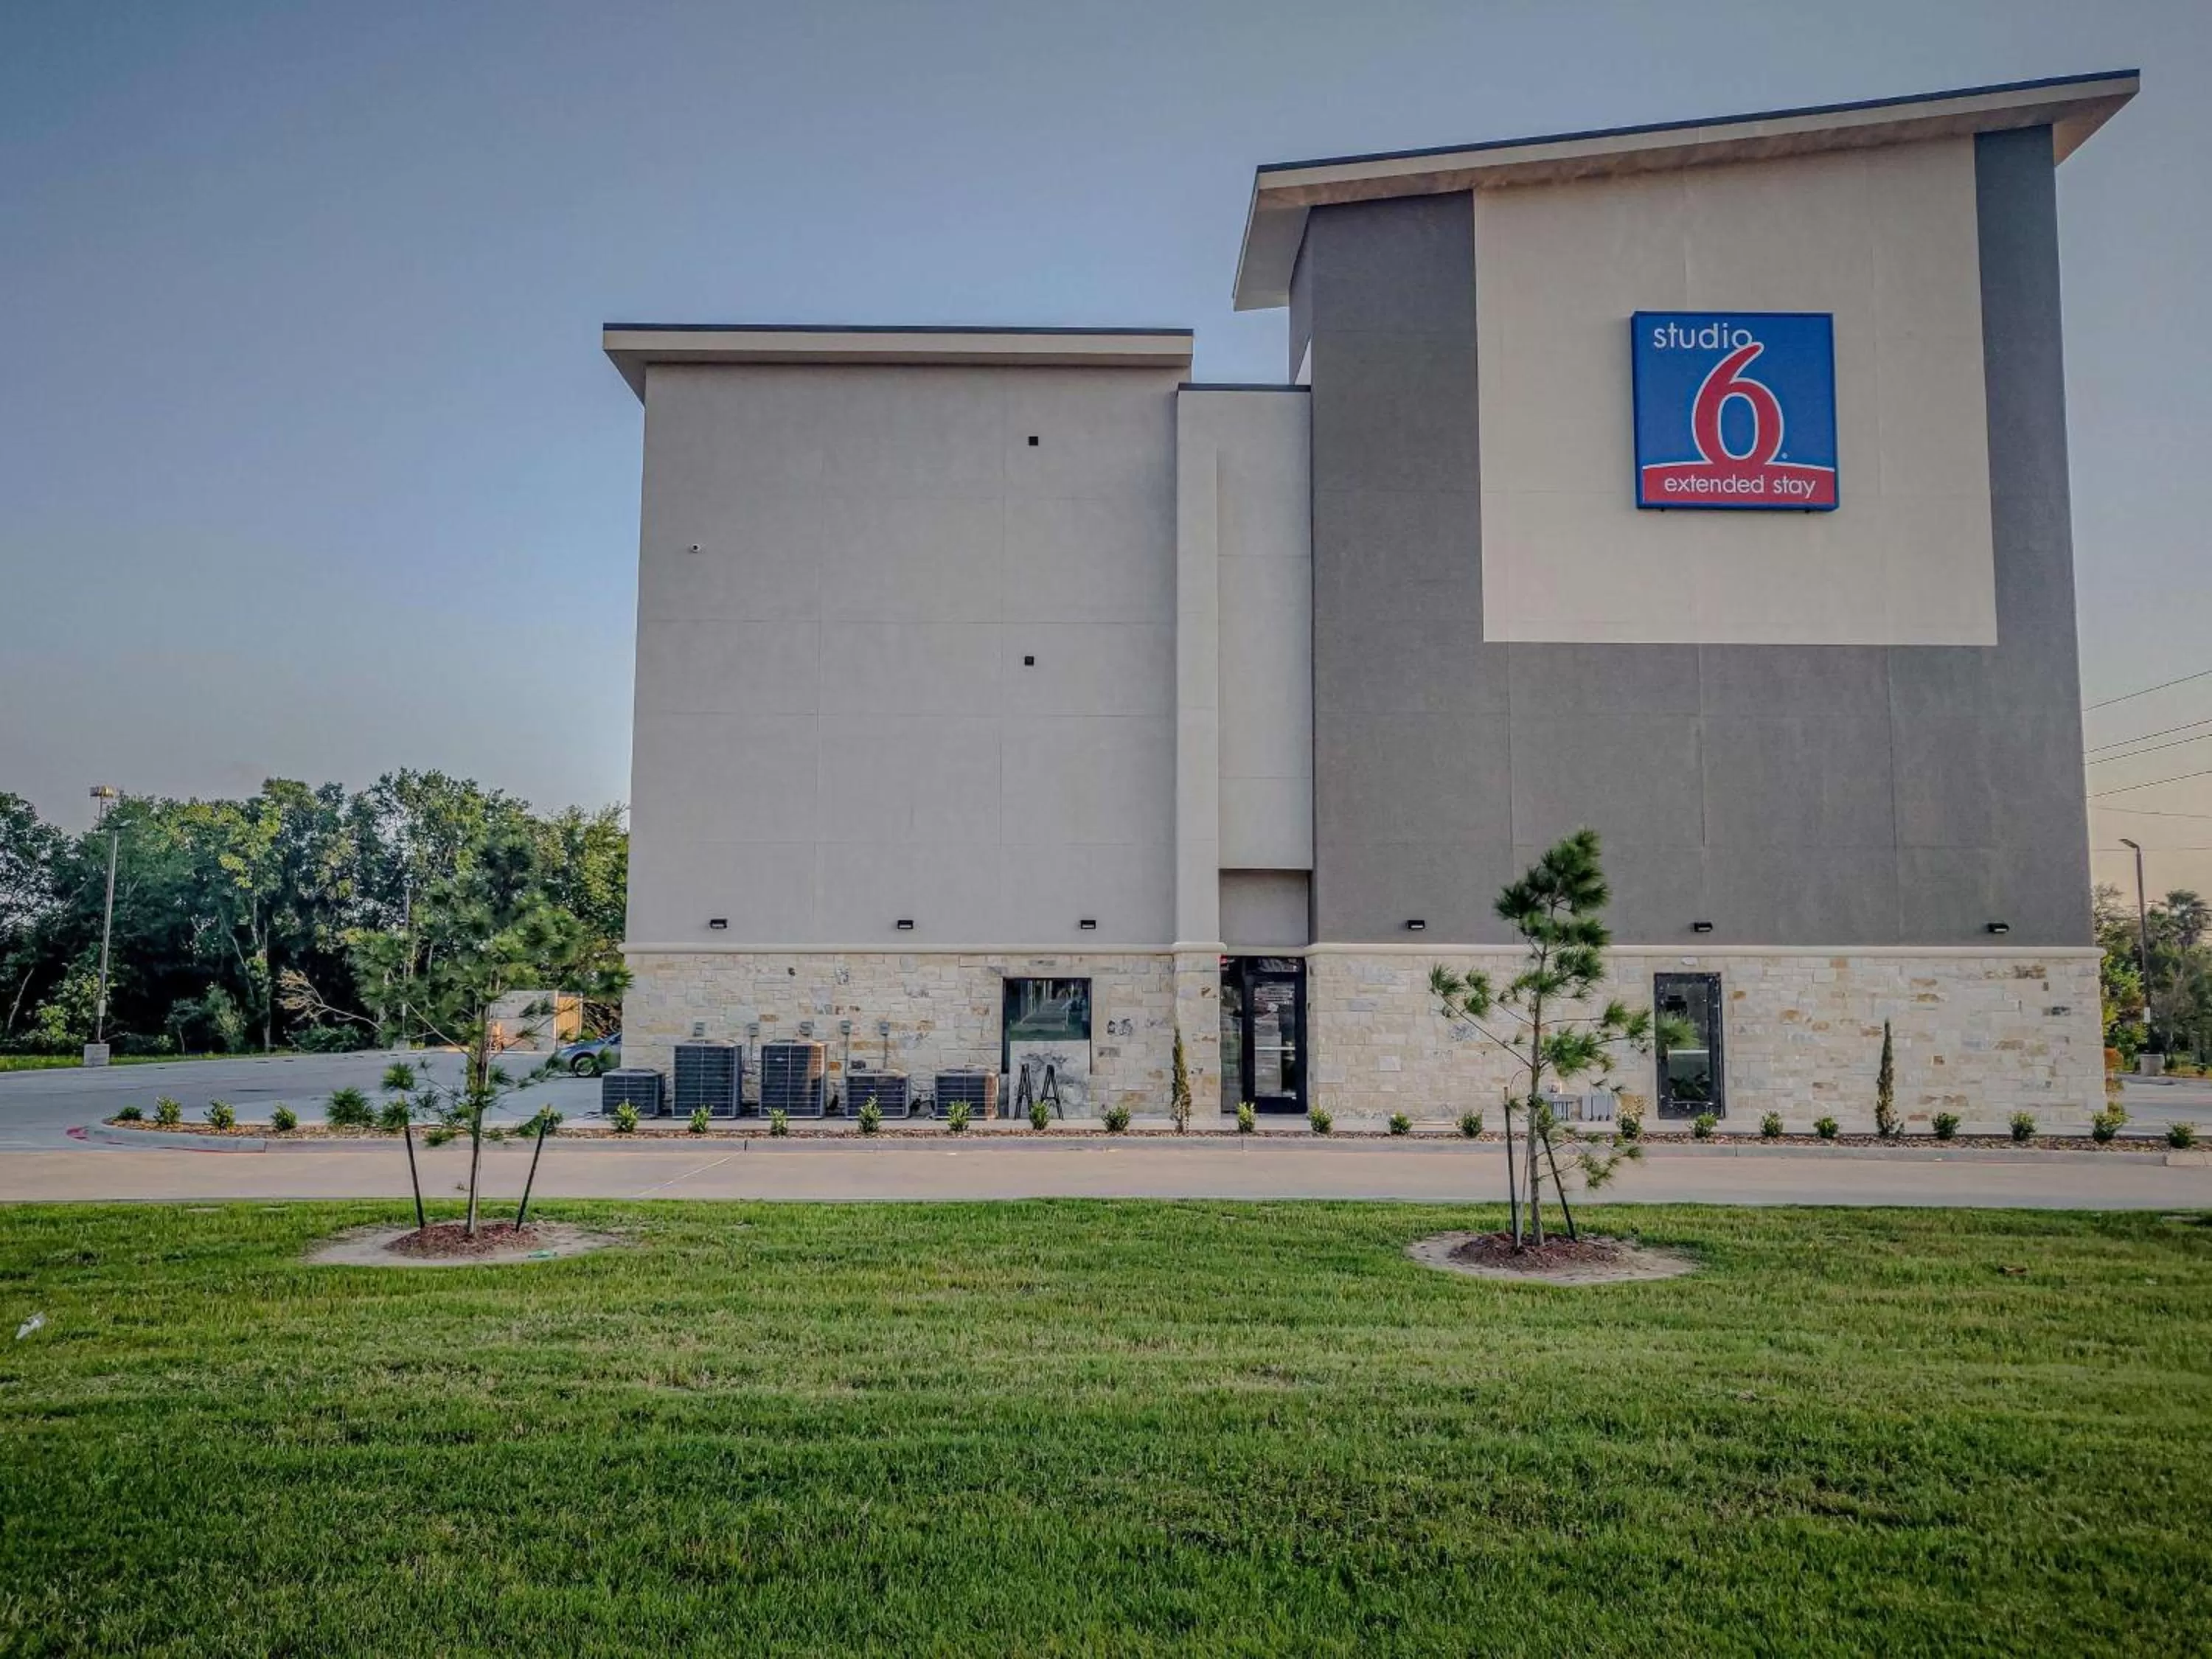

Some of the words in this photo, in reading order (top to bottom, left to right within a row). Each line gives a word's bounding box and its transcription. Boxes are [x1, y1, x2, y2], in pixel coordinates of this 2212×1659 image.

[1653, 322, 1753, 349] studio
[1691, 341, 1784, 464] 6
[1664, 475, 1764, 493] extended
[1773, 476, 1816, 498] stay
